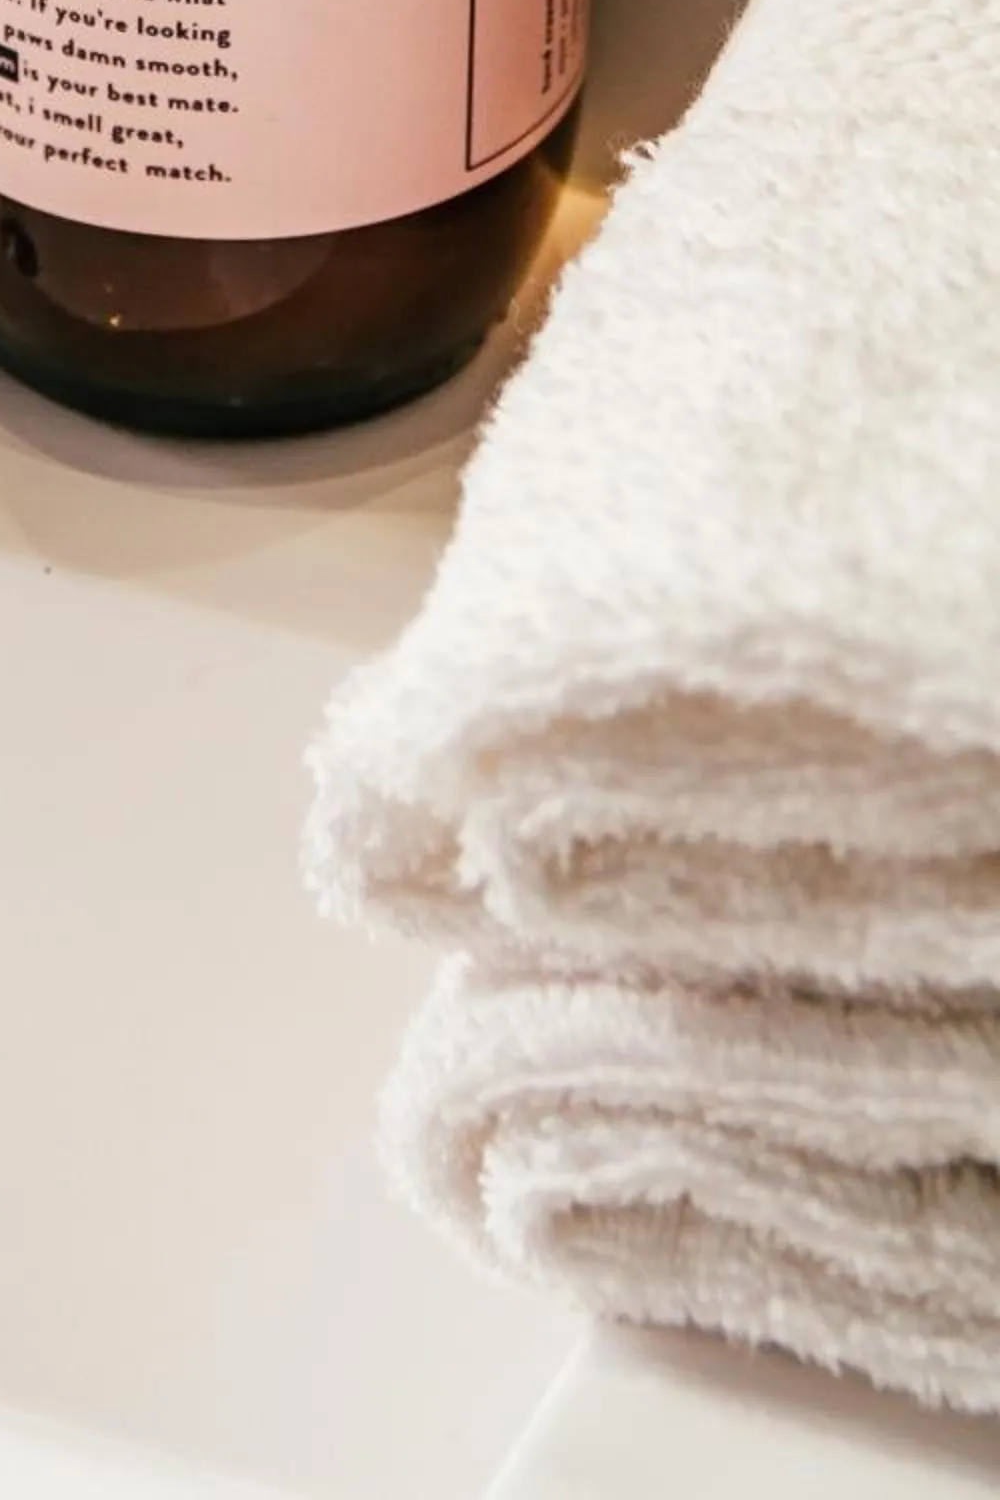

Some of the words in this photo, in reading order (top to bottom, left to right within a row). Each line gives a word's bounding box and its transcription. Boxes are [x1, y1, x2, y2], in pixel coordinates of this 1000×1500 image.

[4, 24, 53, 52] paws
[62, 38, 126, 69] damn
[135, 58, 238, 82] smooth,
[55, 6, 128, 33] you're
[137, 16, 232, 49] looking
[23, 59, 39, 81] is
[47, 74, 98, 97] your
[107, 83, 158, 108] best
[168, 97, 239, 113] mate.
[29, 96, 35, 115] i
[43, 107, 102, 134] smell
[112, 125, 184, 149] great,
[44, 143, 128, 174] perfect
[145, 163, 232, 183] match.
